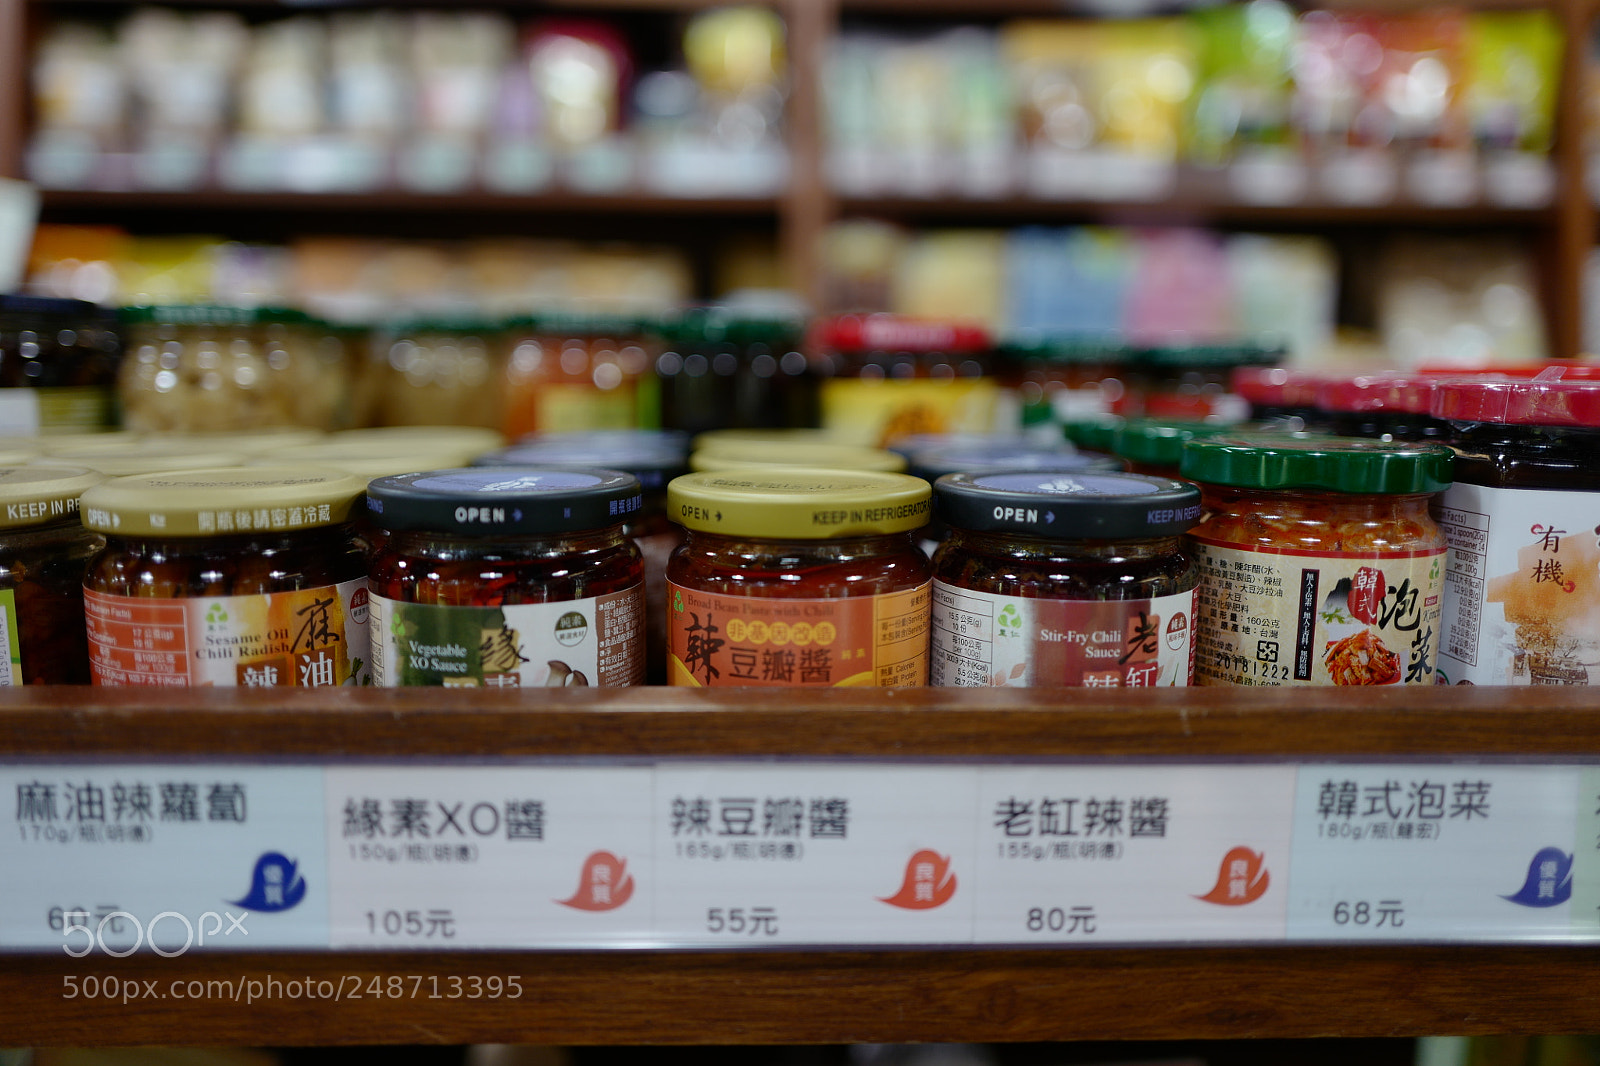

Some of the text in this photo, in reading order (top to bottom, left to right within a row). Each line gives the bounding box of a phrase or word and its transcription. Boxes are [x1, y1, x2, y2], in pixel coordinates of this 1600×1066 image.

[7, 503, 47, 520] KEEP
[51, 501, 64, 516] IN
[87, 508, 110, 528] OPEN
[455, 507, 505, 523] OPEN
[681, 505, 710, 521] OPEN
[812, 510, 848, 525] KEEP
[850, 508, 863, 522] IN
[865, 500, 928, 522] REFRIGERATOR
[993, 506, 1038, 524] OPEN
[1147, 509, 1174, 524] KEEP
[1175, 508, 1183, 521] IN
[1530, 526, 1565, 587] 有機
[1464, 564, 1478, 577] 100g
[687, 594, 712, 610] Broad
[714, 599, 739, 614] Bean
[1353, 570, 1378, 619] 韓式
[205, 628, 289, 646] Sesame Oil
[1040, 629, 1122, 645] Stir-Fry Chili
[1378, 577, 1434, 683] 泡菜
[196, 642, 290, 661] Chili Radish
[408, 640, 468, 659] Vegetable
[1085, 646, 1121, 659] Sauce
[409, 655, 468, 674] XO Sauce
[729, 647, 834, 683] 豆瓣醬
[1216, 653, 1289, 680] 20181222
[15, 780, 247, 824] 麻油辣蘿蔔
[1316, 780, 1492, 821] 韓式泡菜
[670, 796, 849, 839] 辣豆瓣醬
[993, 796, 1169, 838] 老缸辣醬
[365, 909, 456, 939] 105元
[706, 907, 779, 936] 55元
[1026, 906, 1097, 934] 80元
[1333, 900, 1405, 928] 68元
